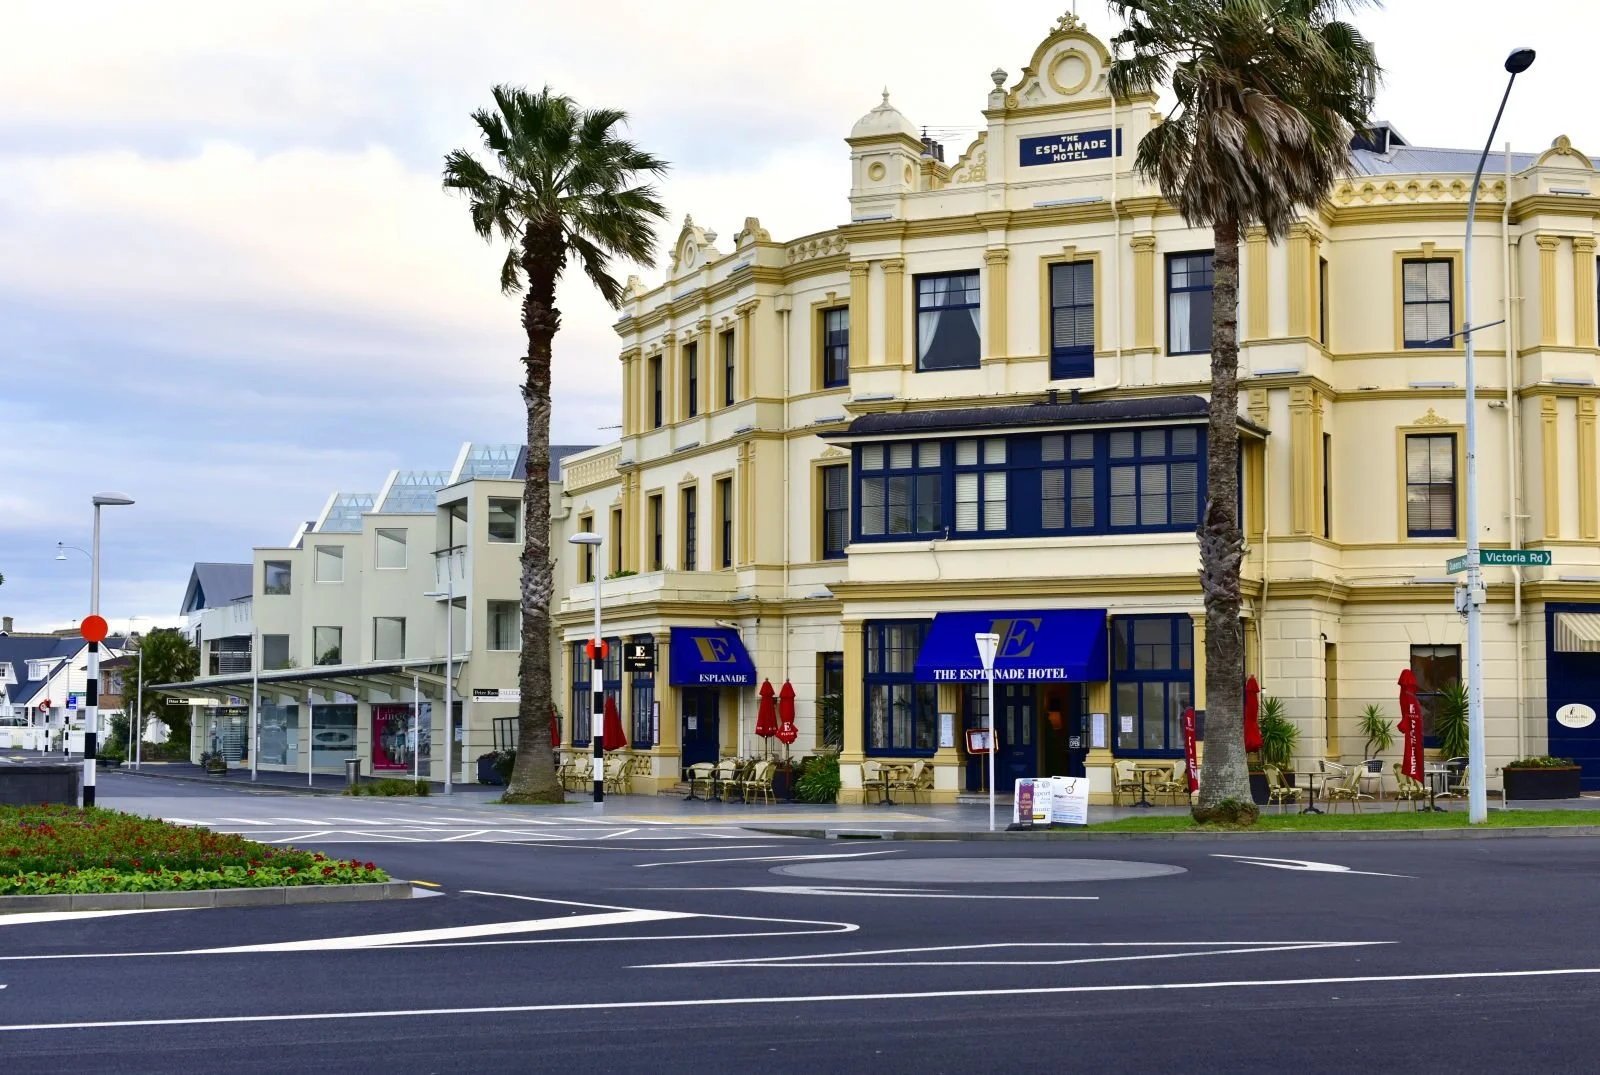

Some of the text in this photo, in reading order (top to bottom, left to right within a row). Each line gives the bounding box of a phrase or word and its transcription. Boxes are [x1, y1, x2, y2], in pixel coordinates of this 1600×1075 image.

[1035, 140, 1107, 155] ESPLANADE
[1053, 151, 1088, 161] HOTEL
[1485, 552, 1543, 563] Victoria Rd
[635, 646, 645, 657] E
[699, 674, 748, 683] ESPLANADE
[933, 668, 1068, 680] THE ESPLNADE HOTEL
